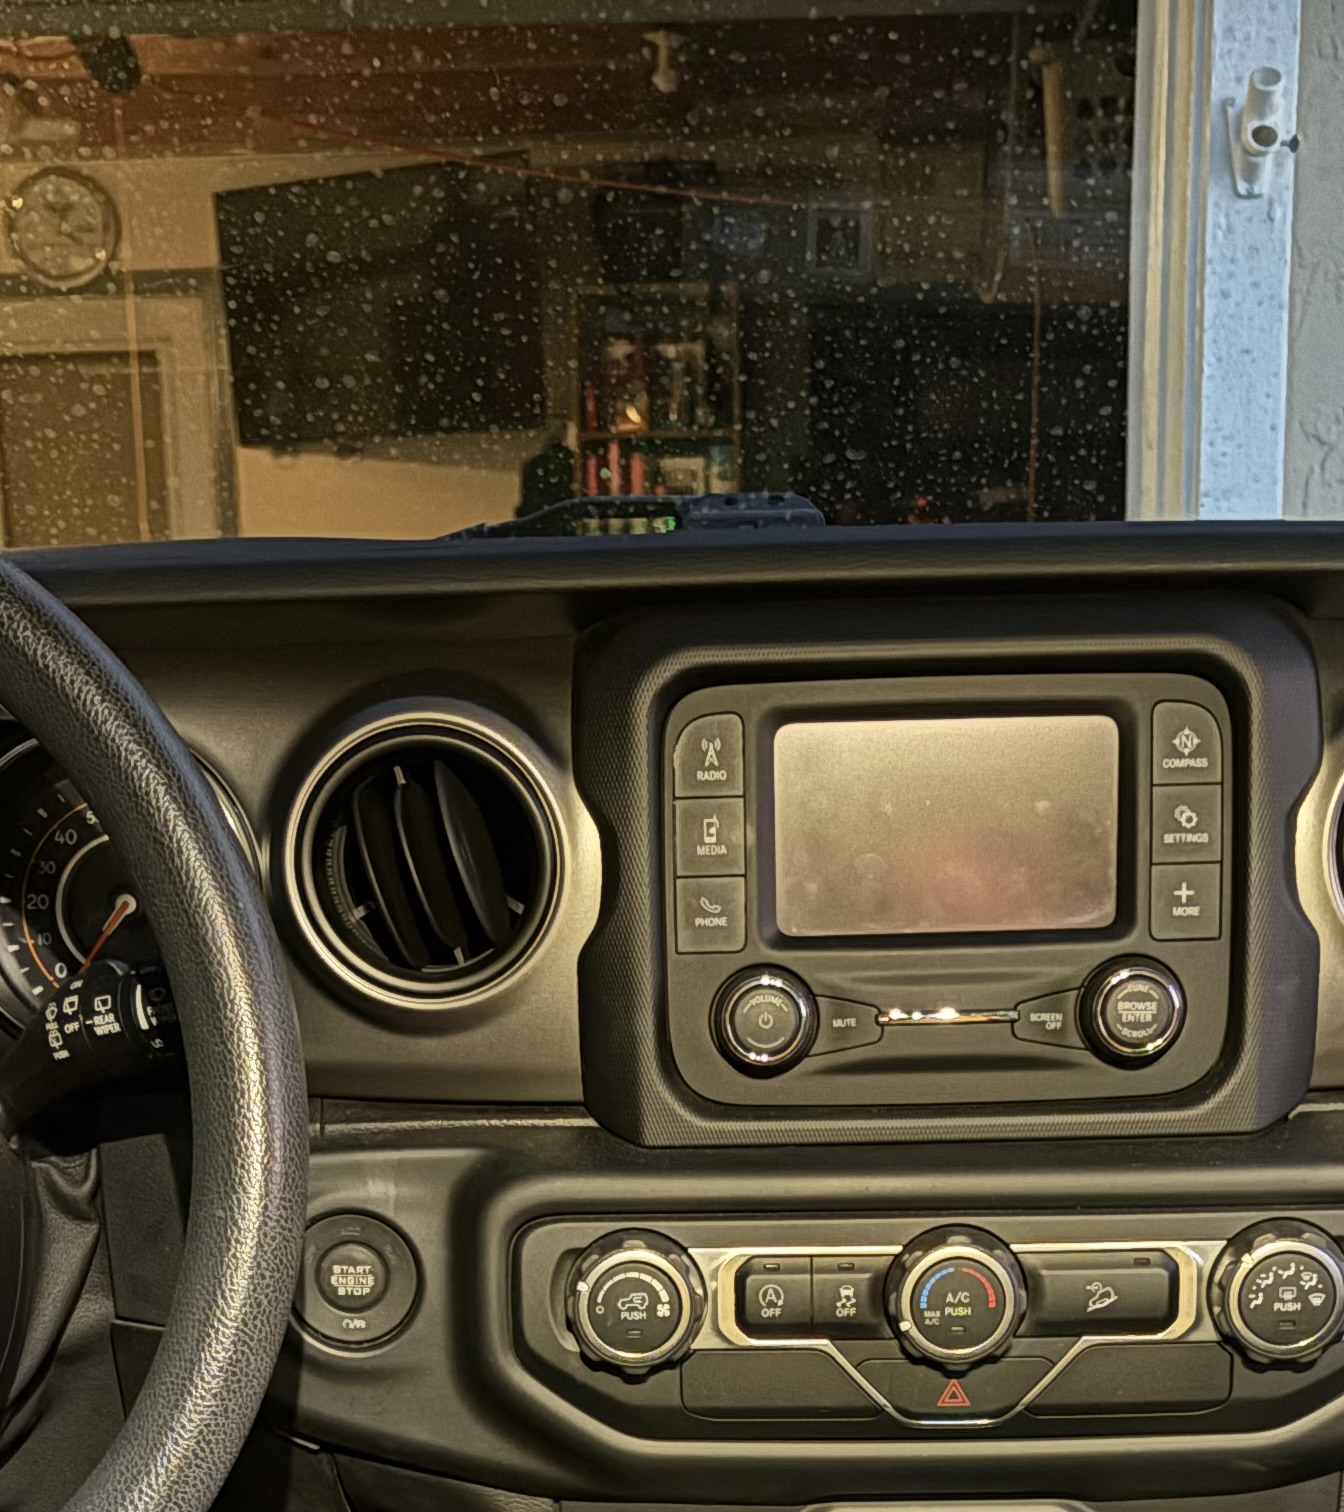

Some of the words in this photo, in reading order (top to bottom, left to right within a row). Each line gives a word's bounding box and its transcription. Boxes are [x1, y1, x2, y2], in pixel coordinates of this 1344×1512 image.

[1162, 757, 1209, 768] COMPASS
[696, 770, 728, 781] RADIO
[54, 828, 78, 845] 40
[1163, 832, 1209, 844] SETTINGS
[696, 844, 728, 855] MEDIA
[38, 860, 56, 874] 30
[27, 893, 49, 910] 20
[1172, 906, 1201, 917] MORE
[694, 916, 729, 927] PHONE
[37, 931, 52, 946] 10
[54, 962, 68, 979] 0
[1127, 983, 1150, 993] TUNE
[749, 994, 783, 1008] VOLUME
[1117, 1000, 1158, 1011] BROWSE
[93, 1012, 116, 1026] REAR
[832, 1017, 857, 1028] MUTE
[1029, 1012, 1064, 1022] SCREEN
[1121, 1012, 1153, 1023] ENTER
[63, 1021, 80, 1034] OFF
[93, 1022, 122, 1036] WIPER
[1044, 1021, 1063, 1031] OFF
[1120, 1026, 1154, 1039] SCROLL
[332, 1264, 373, 1275] START
[330, 1275, 375, 1286] ENGINE
[337, 1286, 372, 1296] STOP
[945, 1291, 971, 1305] A/C
[944, 1306, 972, 1317] PUSH
[1273, 1301, 1302, 1312] PUSH
[620, 1310, 647, 1321] PUSH
[760, 1307, 783, 1318] OFF
[835, 1307, 857, 1318] OFF
[924, 1318, 941, 1326] A/C
